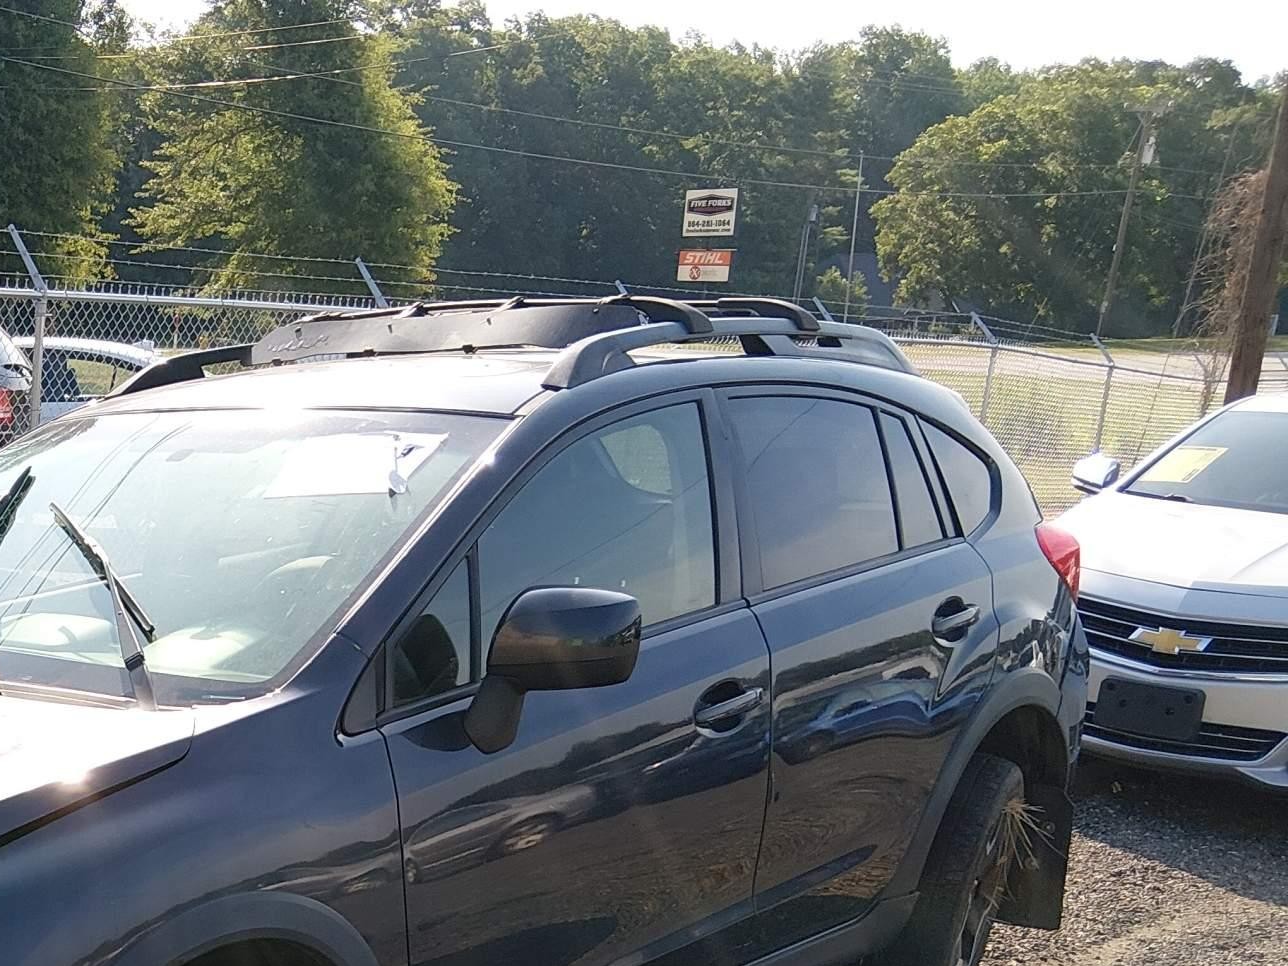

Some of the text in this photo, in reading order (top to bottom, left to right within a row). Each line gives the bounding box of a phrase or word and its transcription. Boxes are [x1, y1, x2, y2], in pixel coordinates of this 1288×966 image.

[690, 199, 732, 208] FIVE FORKS
[684, 252, 723, 264] STIHL
